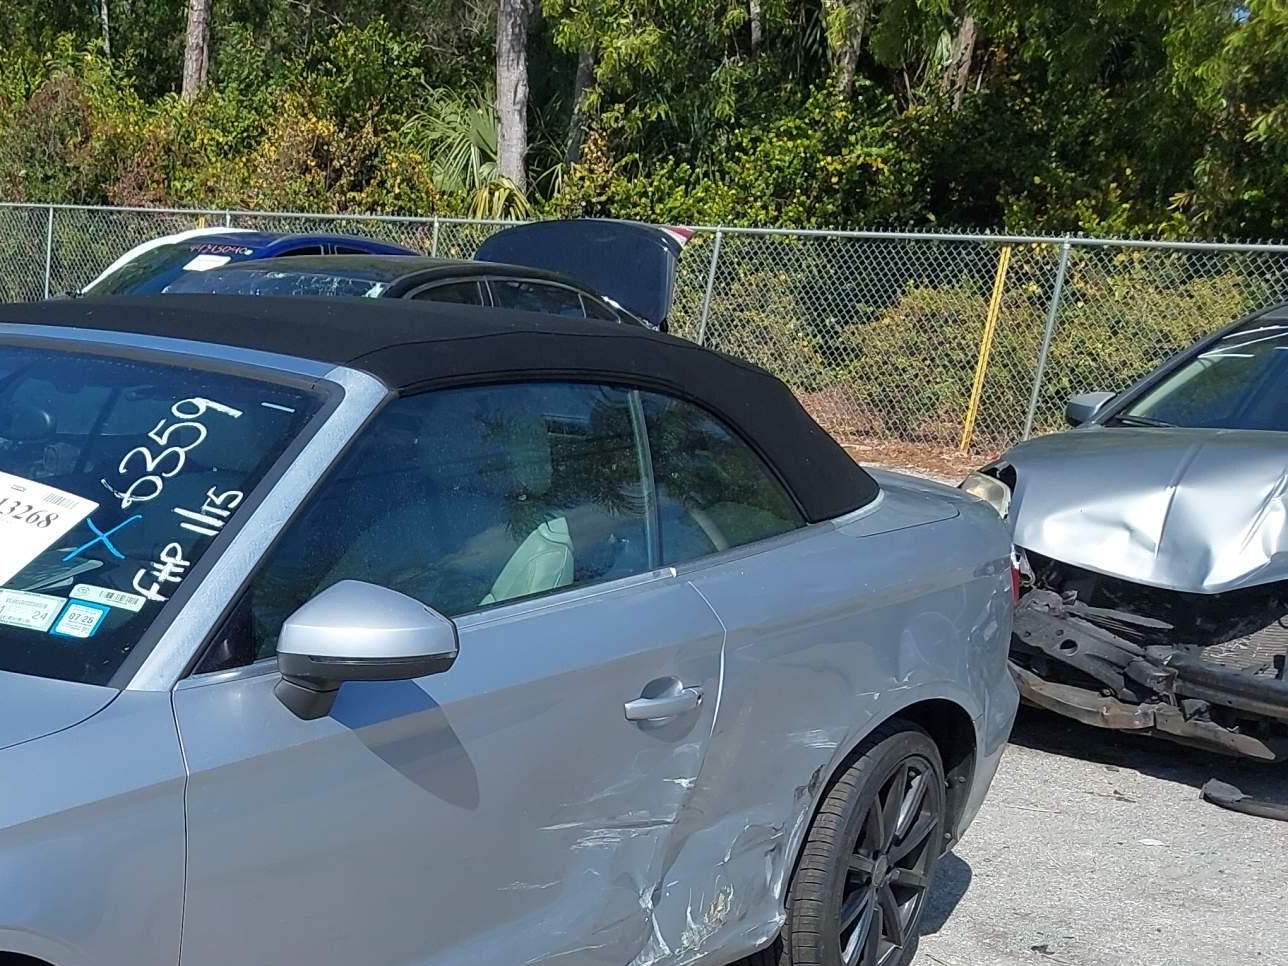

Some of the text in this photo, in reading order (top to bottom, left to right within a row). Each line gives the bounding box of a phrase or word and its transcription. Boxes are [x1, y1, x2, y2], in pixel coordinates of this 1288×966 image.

[100, 397, 244, 510] 6359
[132, 542, 191, 602] FHP
[31, 610, 49, 622] 24
